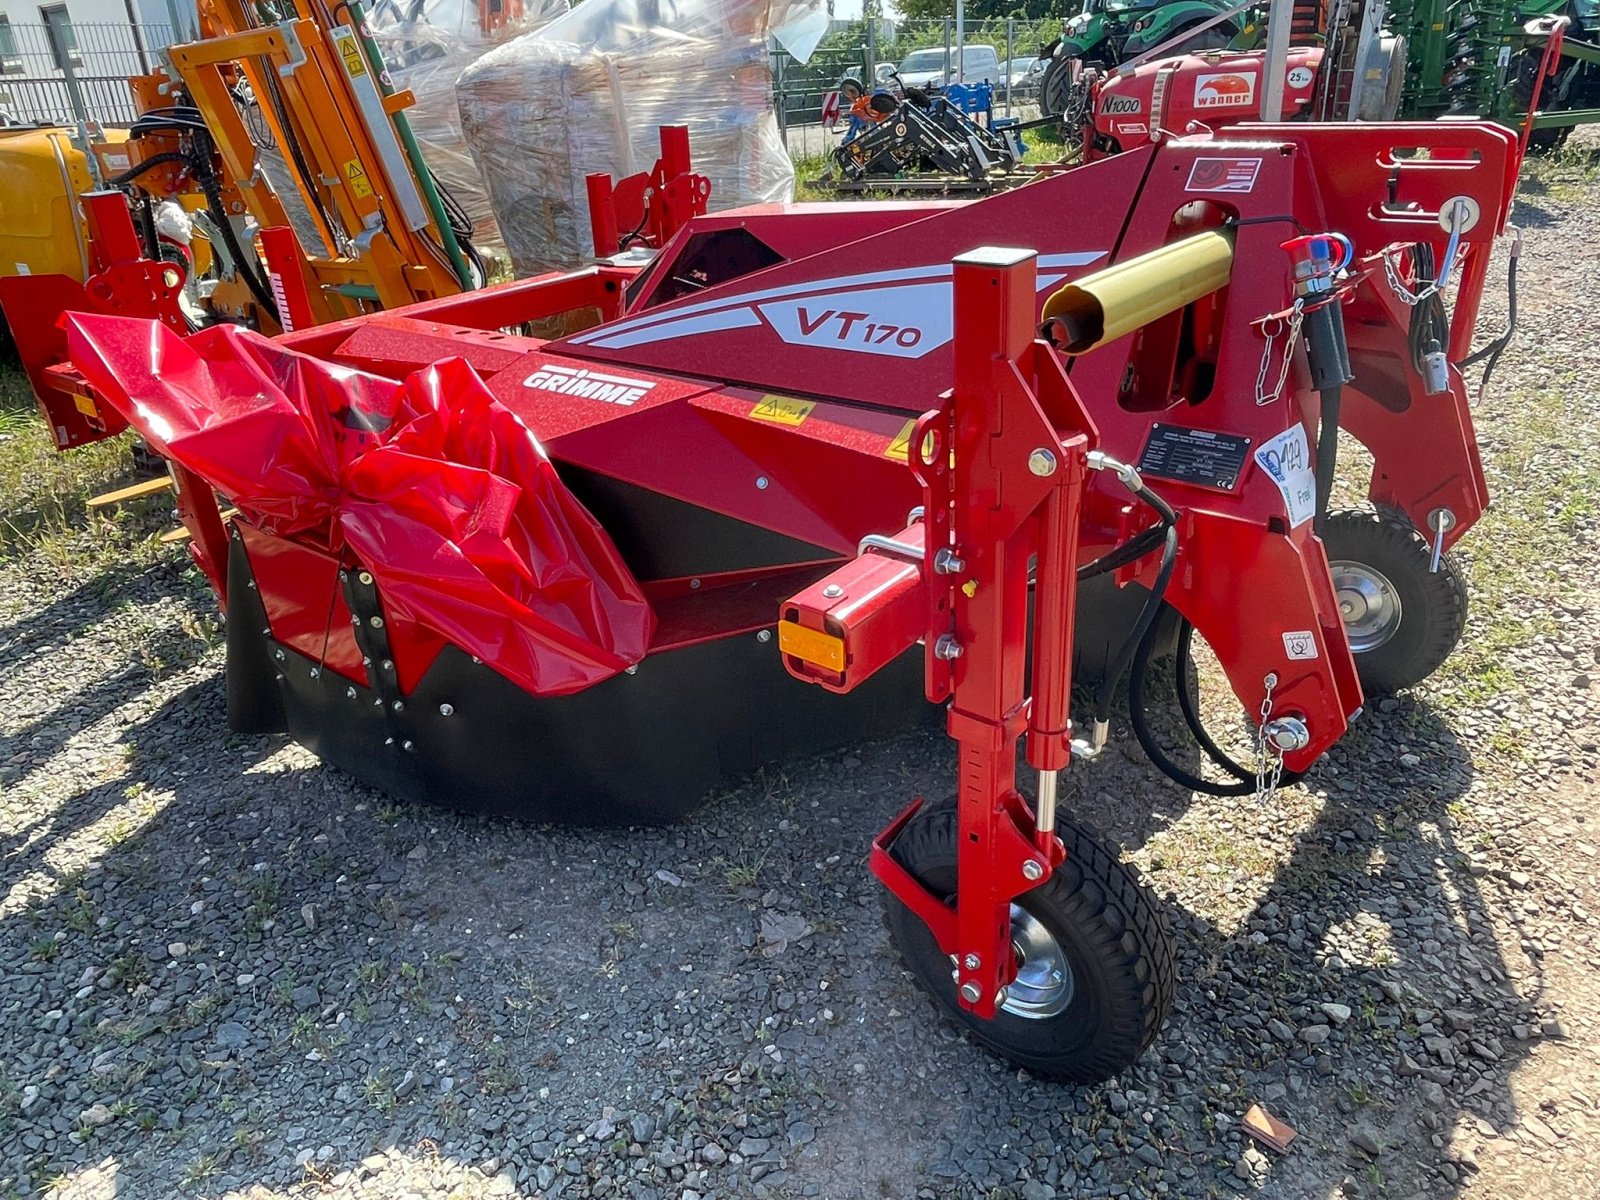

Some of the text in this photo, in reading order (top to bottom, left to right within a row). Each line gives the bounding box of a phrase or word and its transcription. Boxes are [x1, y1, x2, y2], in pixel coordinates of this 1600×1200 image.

[1290, 72, 1301, 81] 25
[1100, 95, 1139, 113] N1000
[1198, 94, 1249, 107] wanner
[797, 307, 922, 348] VT 170
[522, 366, 654, 406] GRIMME
